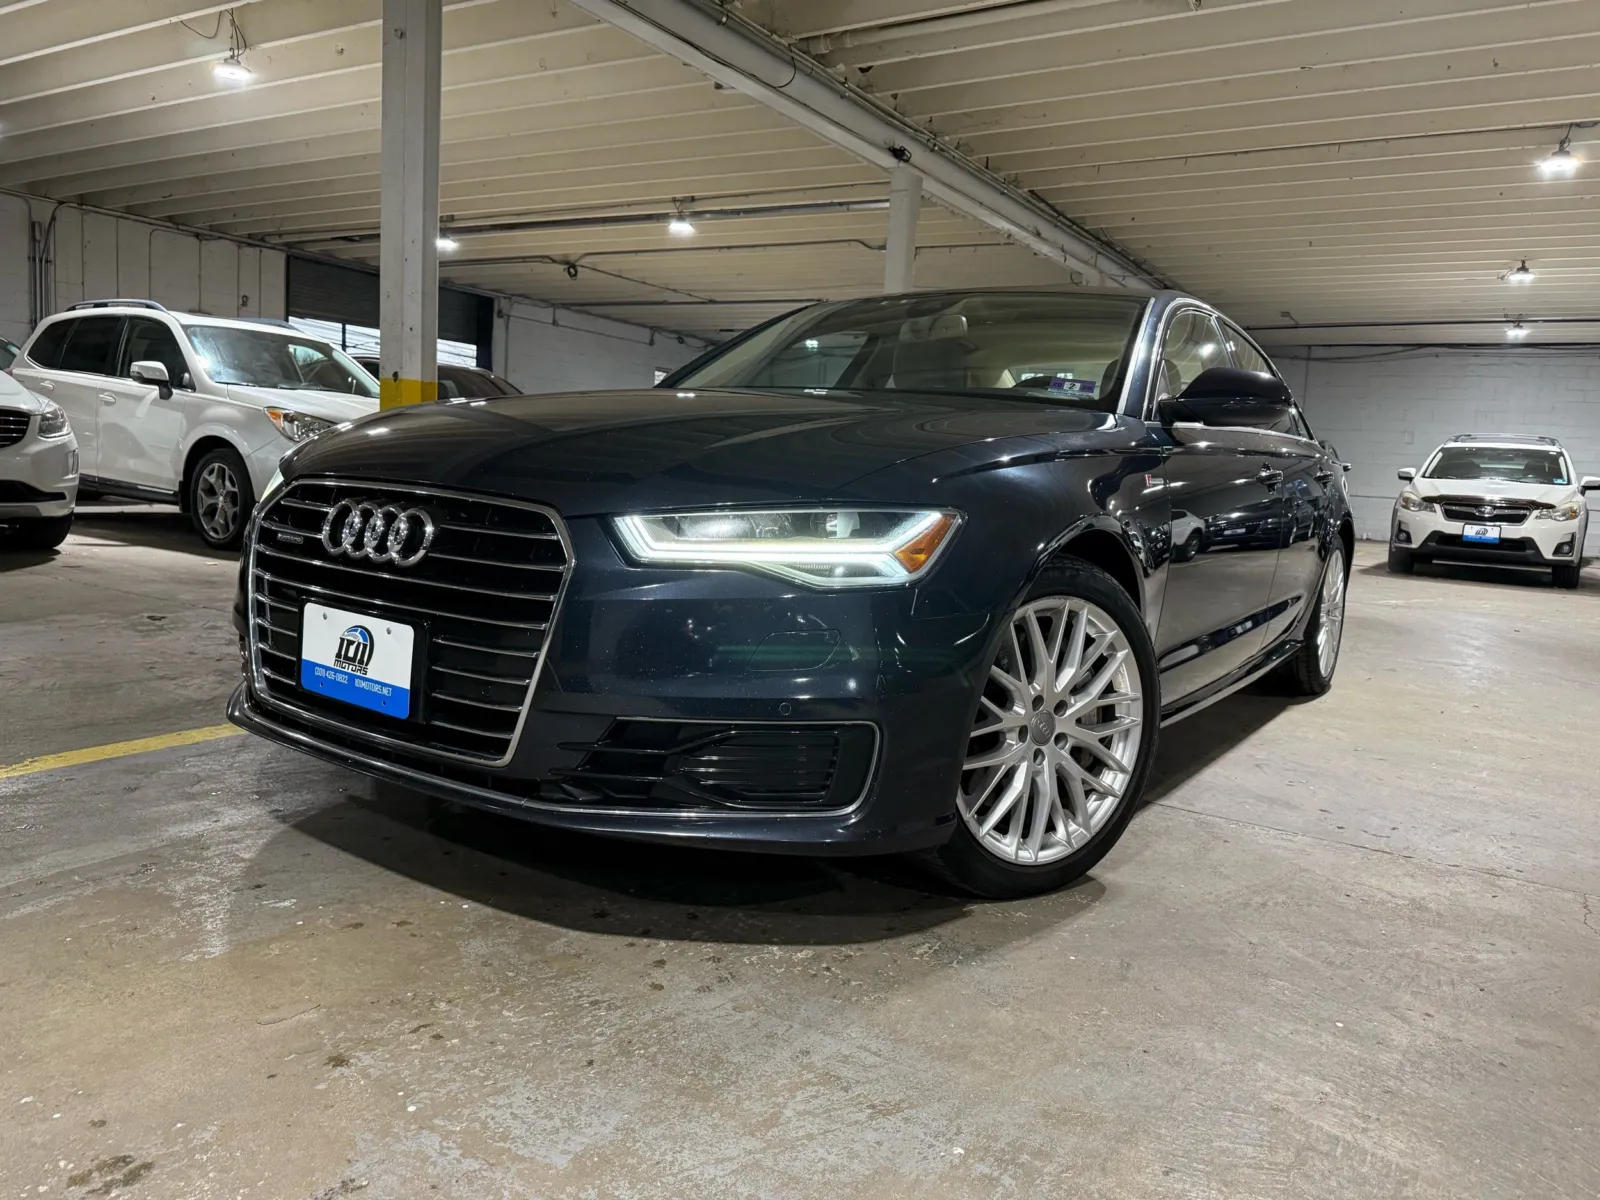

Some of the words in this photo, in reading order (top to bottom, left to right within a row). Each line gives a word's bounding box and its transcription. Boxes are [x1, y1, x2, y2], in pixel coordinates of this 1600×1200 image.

[1068, 382, 1076, 390] 2
[315, 667, 325, 678] (201)
[334, 660, 368, 675] MOTORS
